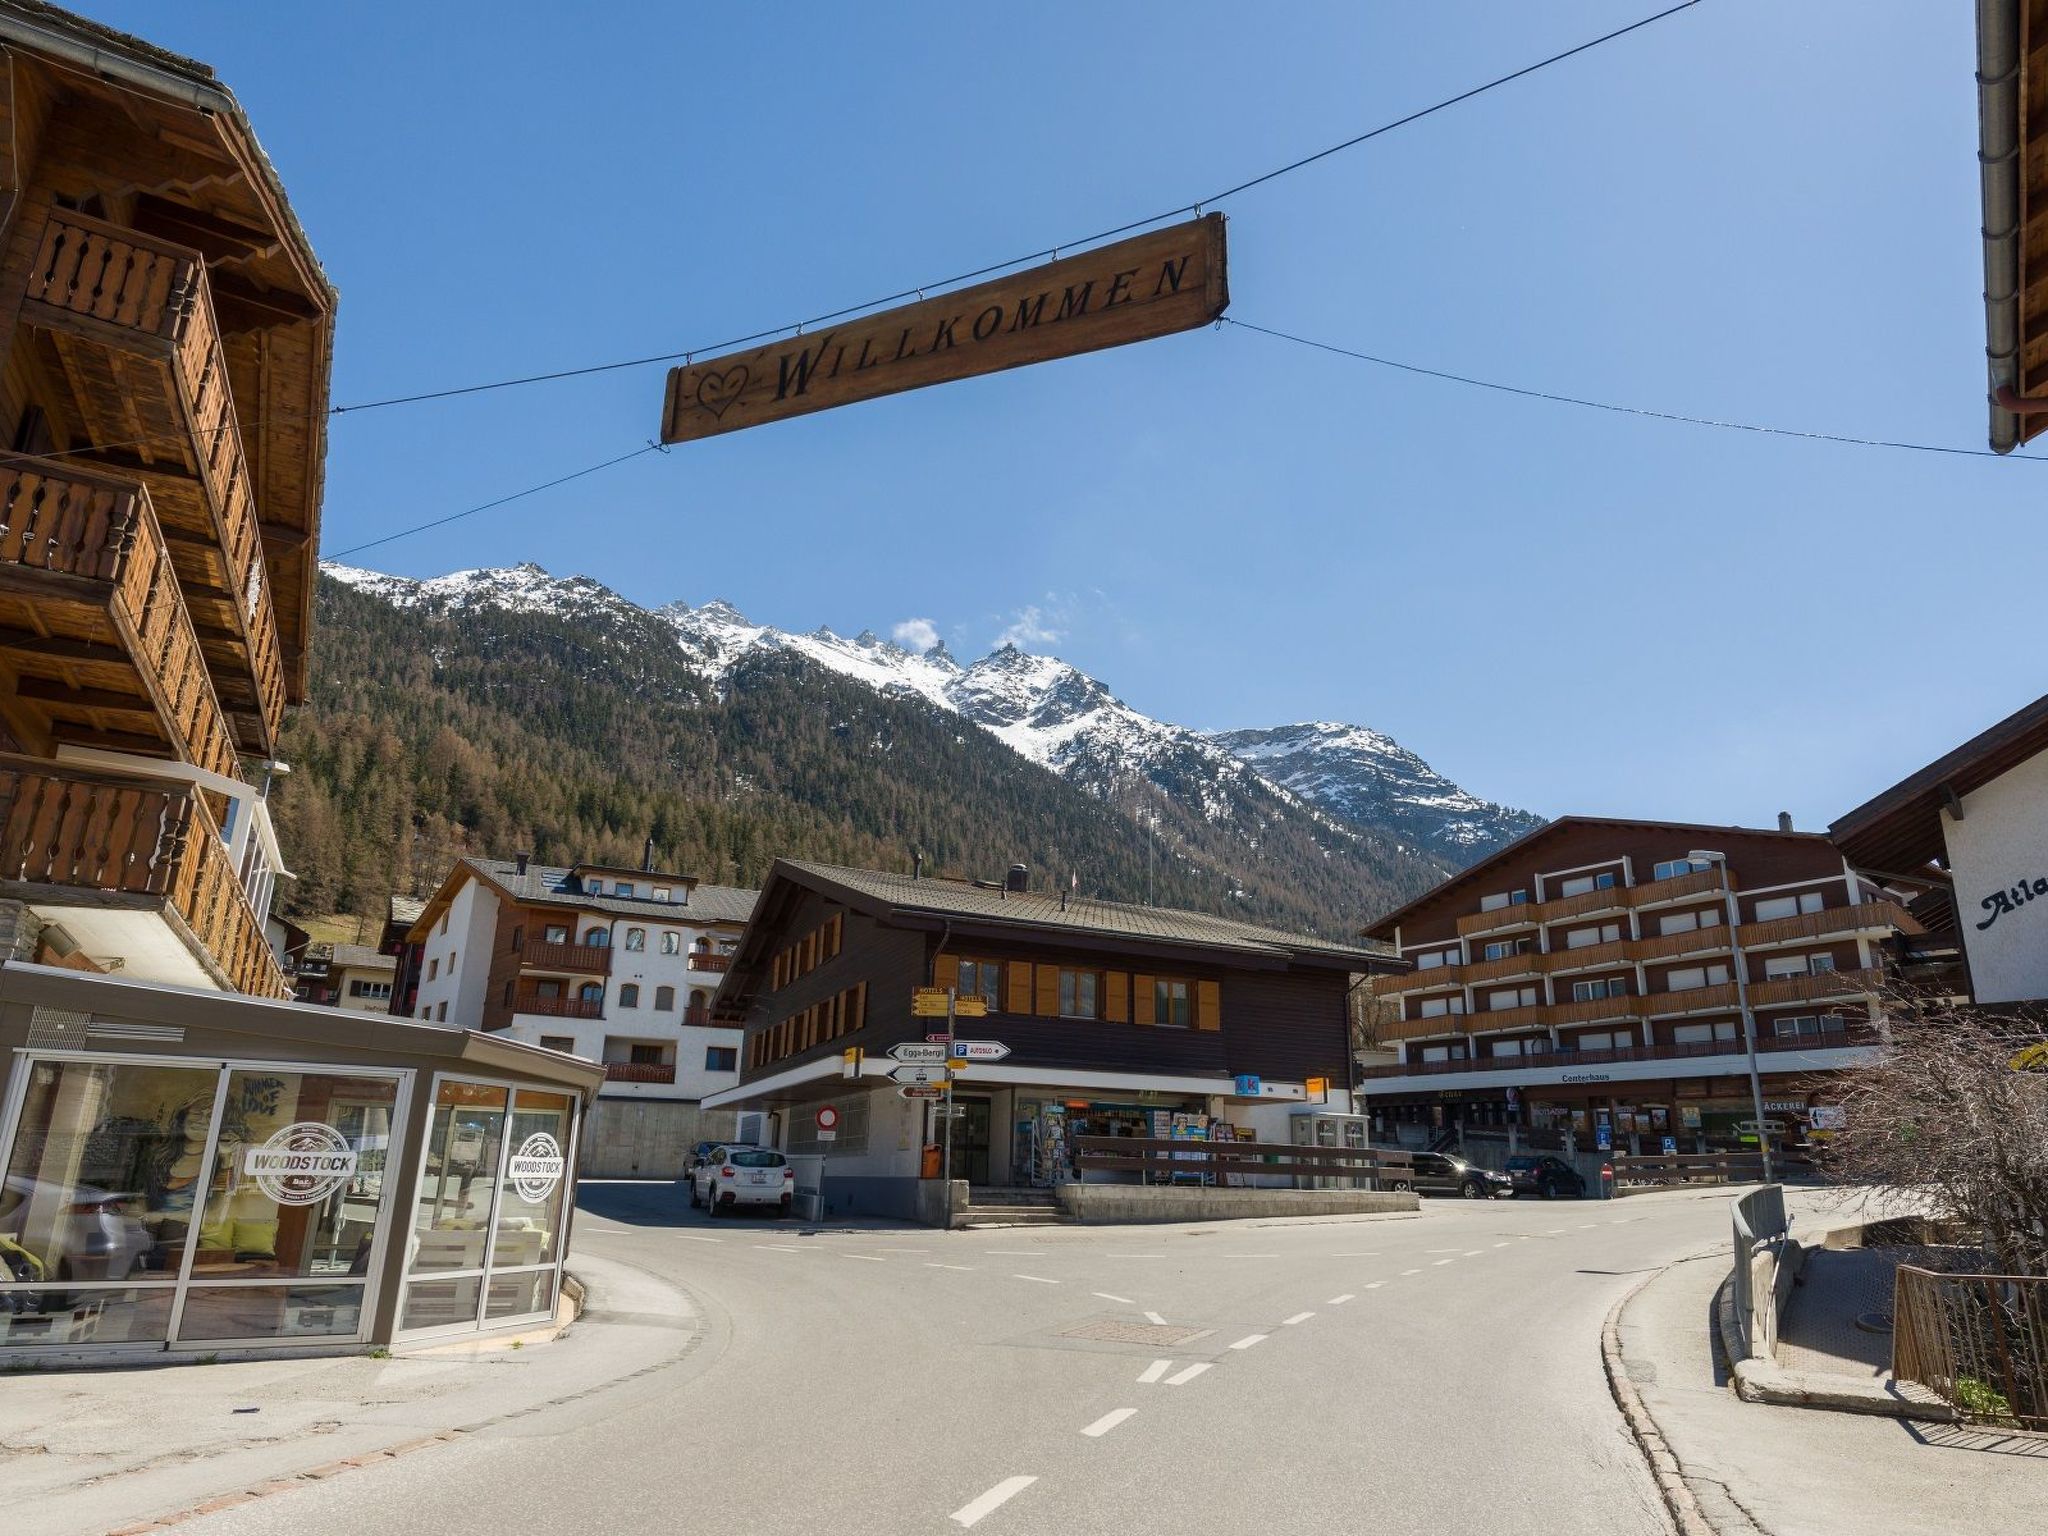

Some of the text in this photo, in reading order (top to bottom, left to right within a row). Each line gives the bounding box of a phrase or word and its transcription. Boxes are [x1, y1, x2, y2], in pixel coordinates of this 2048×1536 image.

[772, 255, 1192, 401] WILLKOMMEN
[1561, 1073, 1610, 1083] Centerhaus
[1764, 1101, 1805, 1112] ÄCKEREI
[254, 1154, 352, 1171] WOODSTOCK
[514, 1160, 561, 1173] WOODSTOCK
